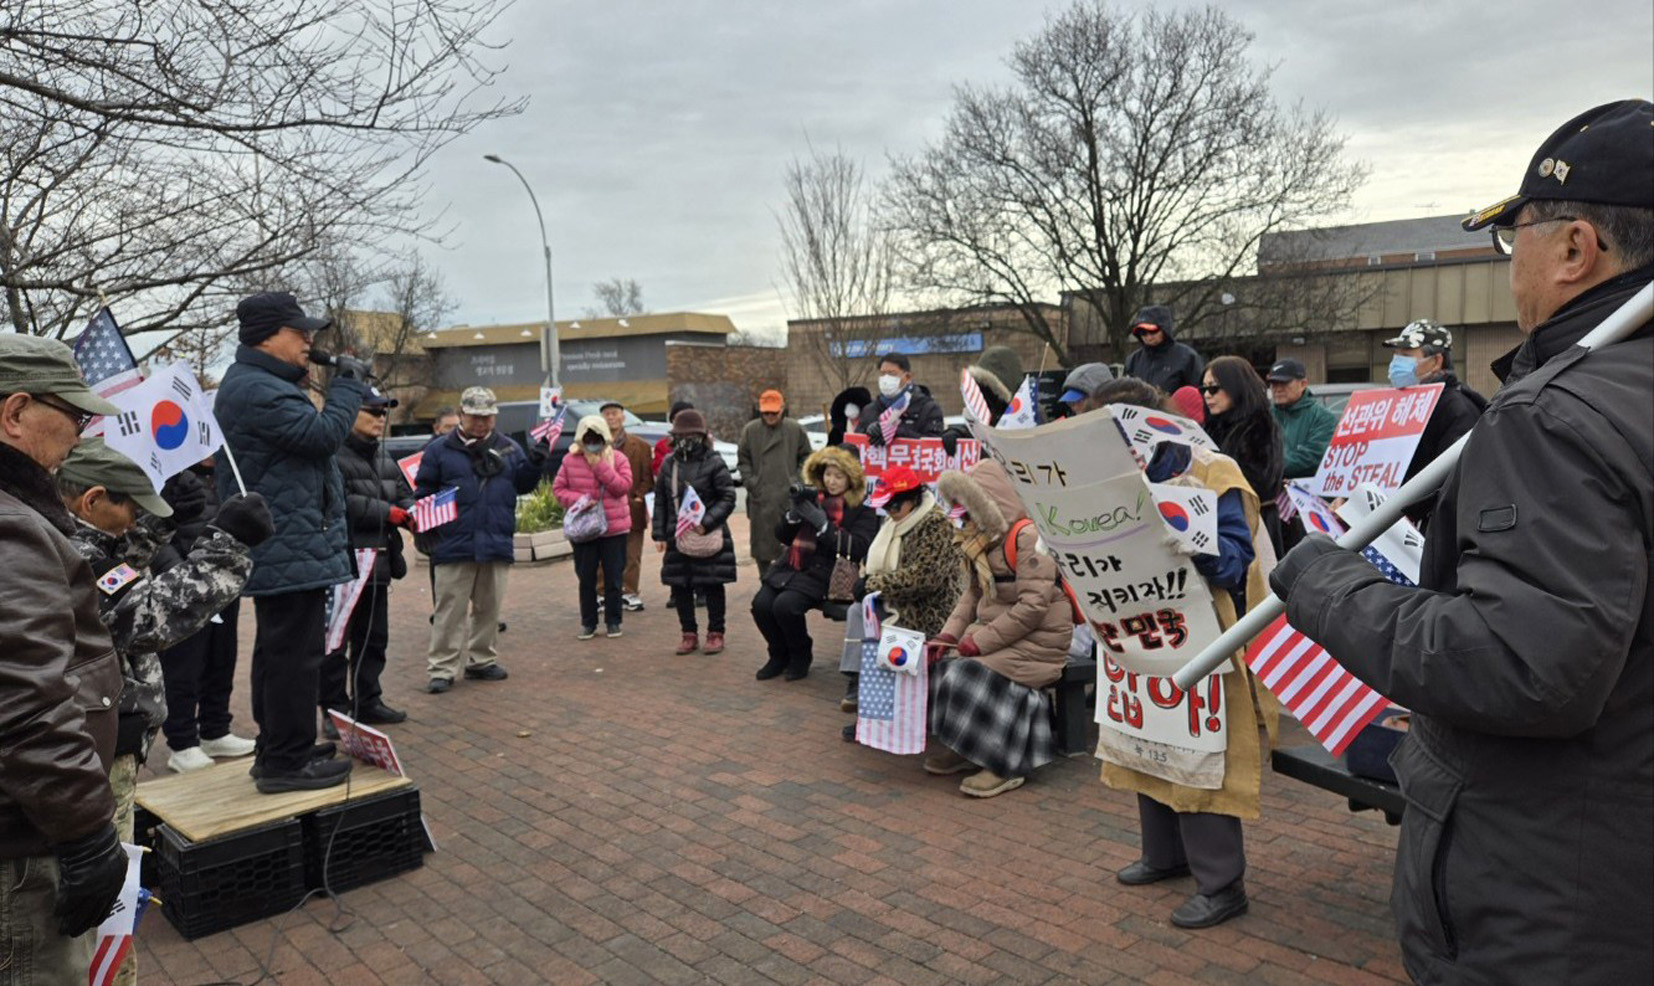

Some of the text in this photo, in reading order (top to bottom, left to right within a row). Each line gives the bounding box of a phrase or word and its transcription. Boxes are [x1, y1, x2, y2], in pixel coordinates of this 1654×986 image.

[1336, 388, 1436, 437] 선관위 해체
[1323, 440, 1369, 469] STOP
[1322, 461, 1400, 492] the STEAL
[1087, 567, 1187, 613] 지키자!!
